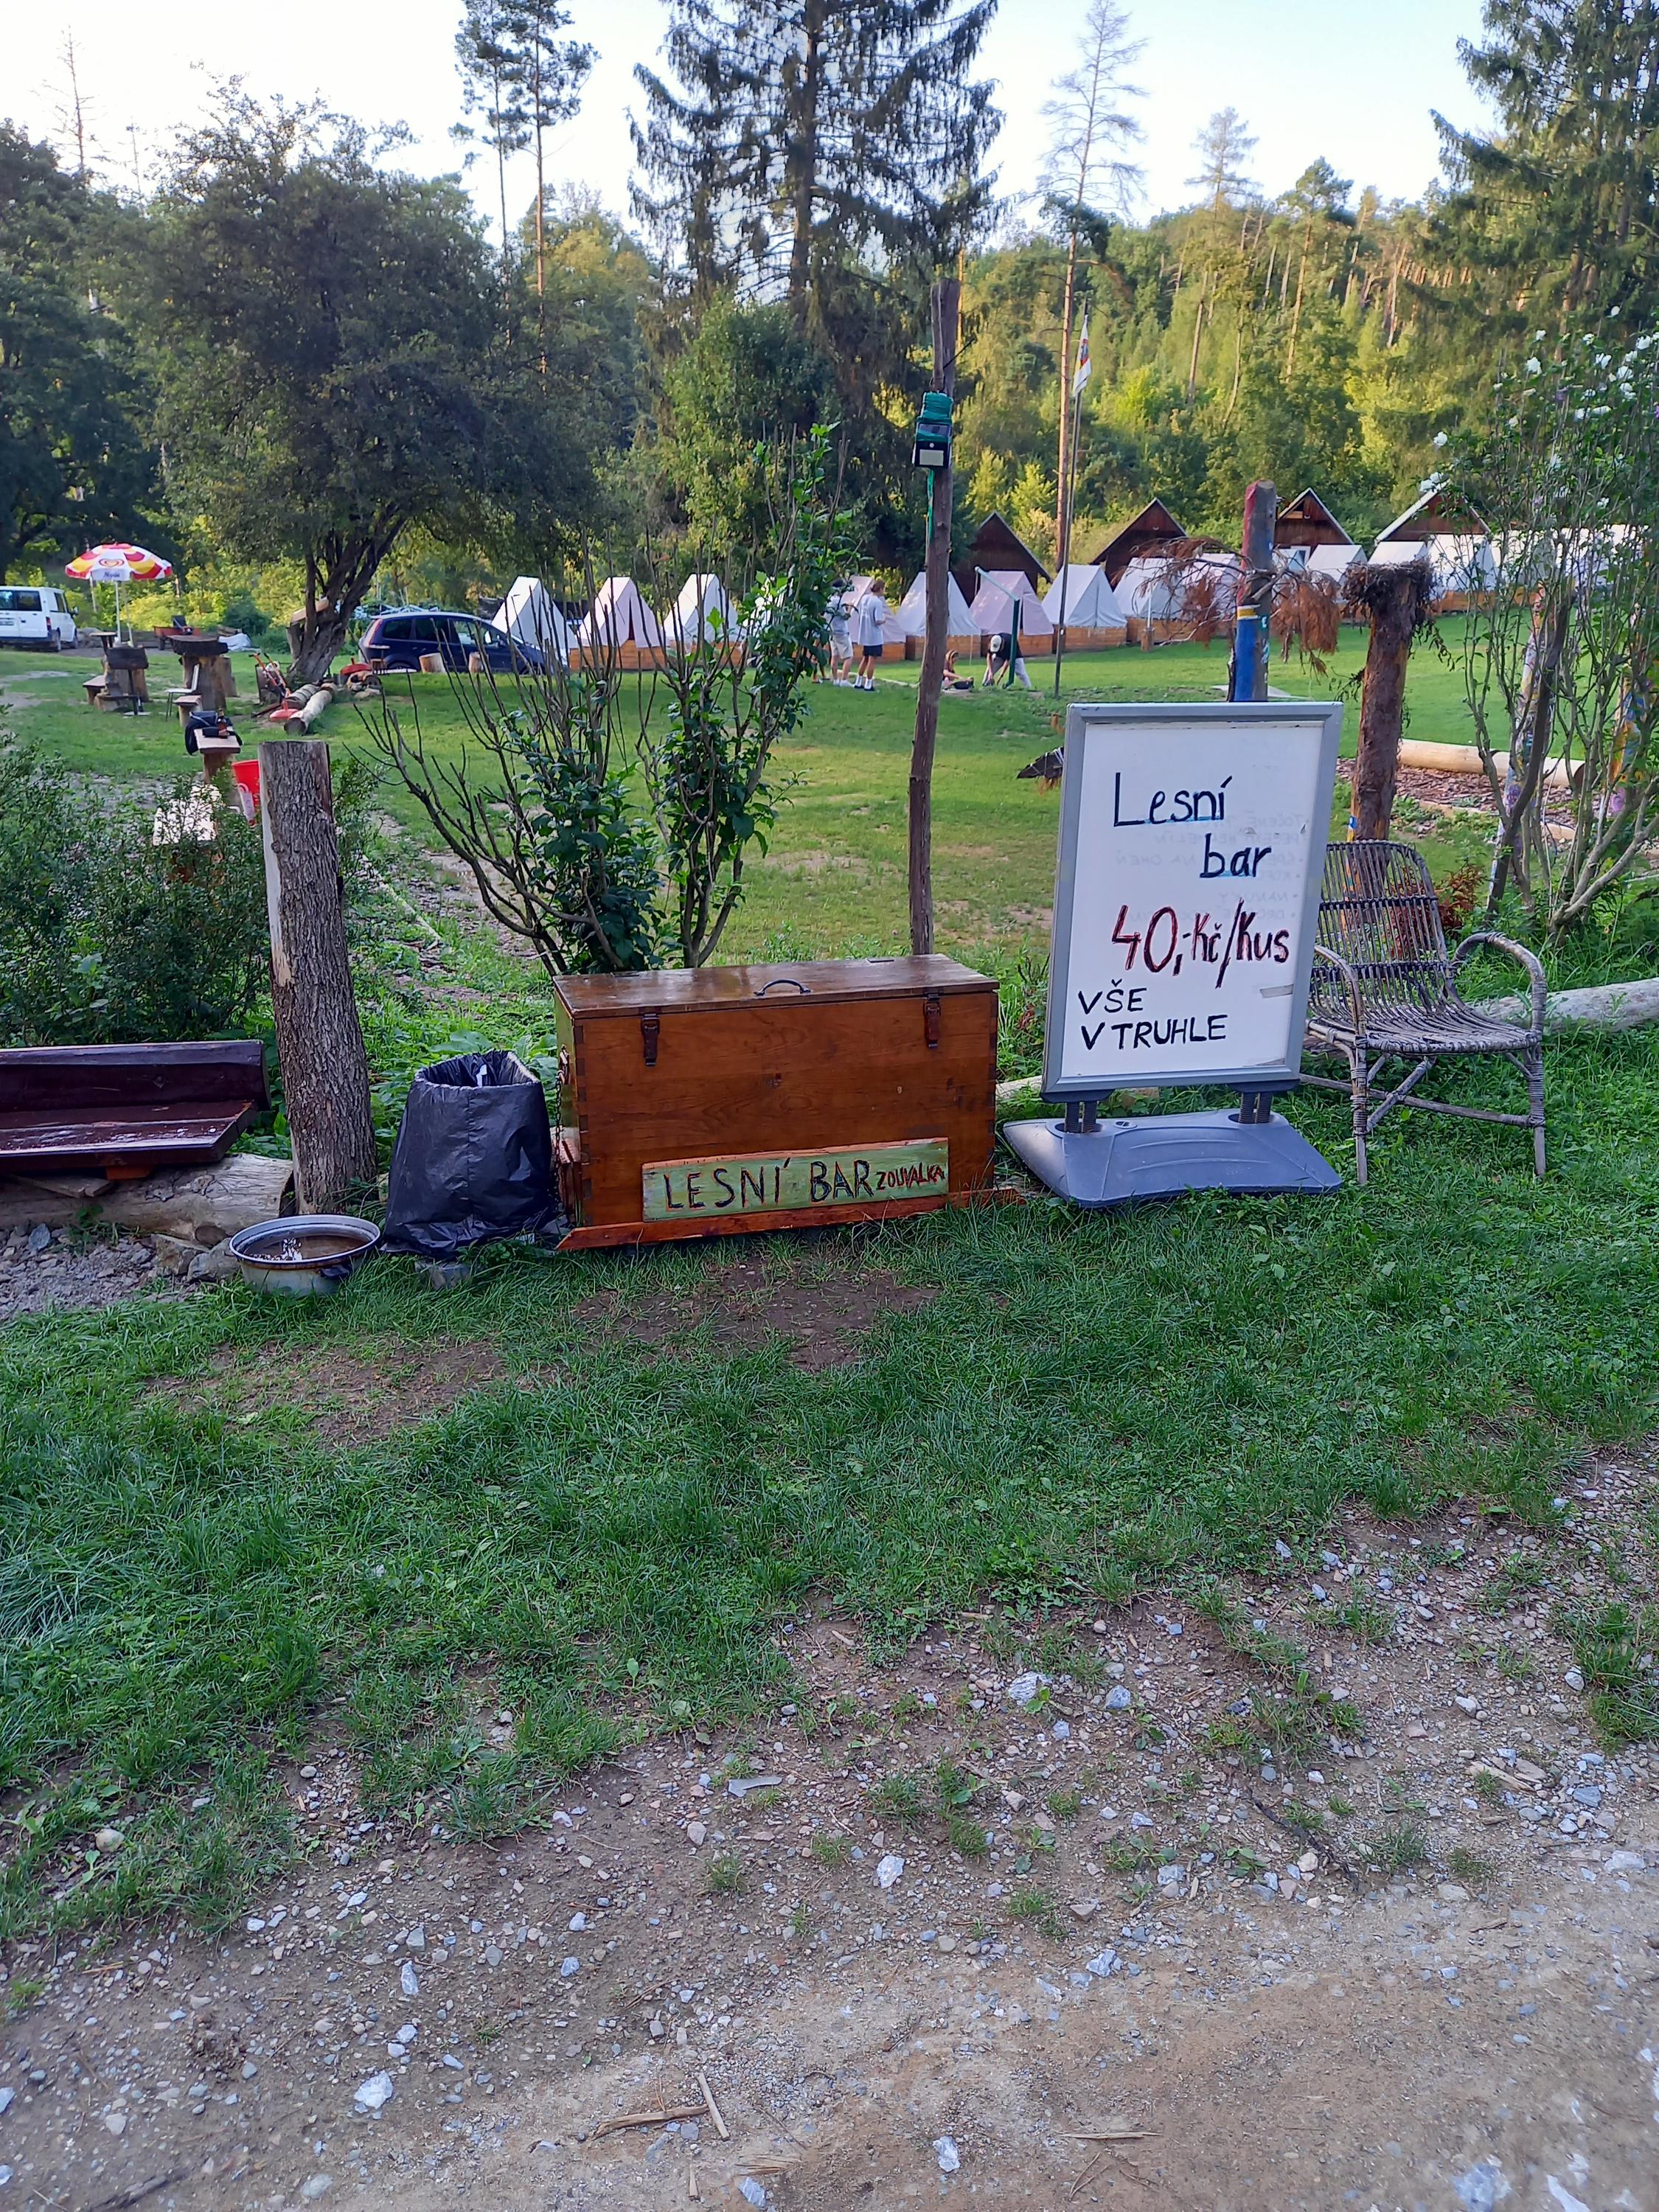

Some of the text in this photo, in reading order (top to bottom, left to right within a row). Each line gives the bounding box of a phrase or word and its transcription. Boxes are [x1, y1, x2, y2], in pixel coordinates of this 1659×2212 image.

[1113, 772, 1232, 827] Lesní
[1199, 832, 1272, 879] bar
[1077, 978, 1147, 1015] VŠE
[1110, 1014, 1228, 1050] TRUHLE
[663, 1157, 945, 1209] LESNÍ BAR ZOUVALKA
